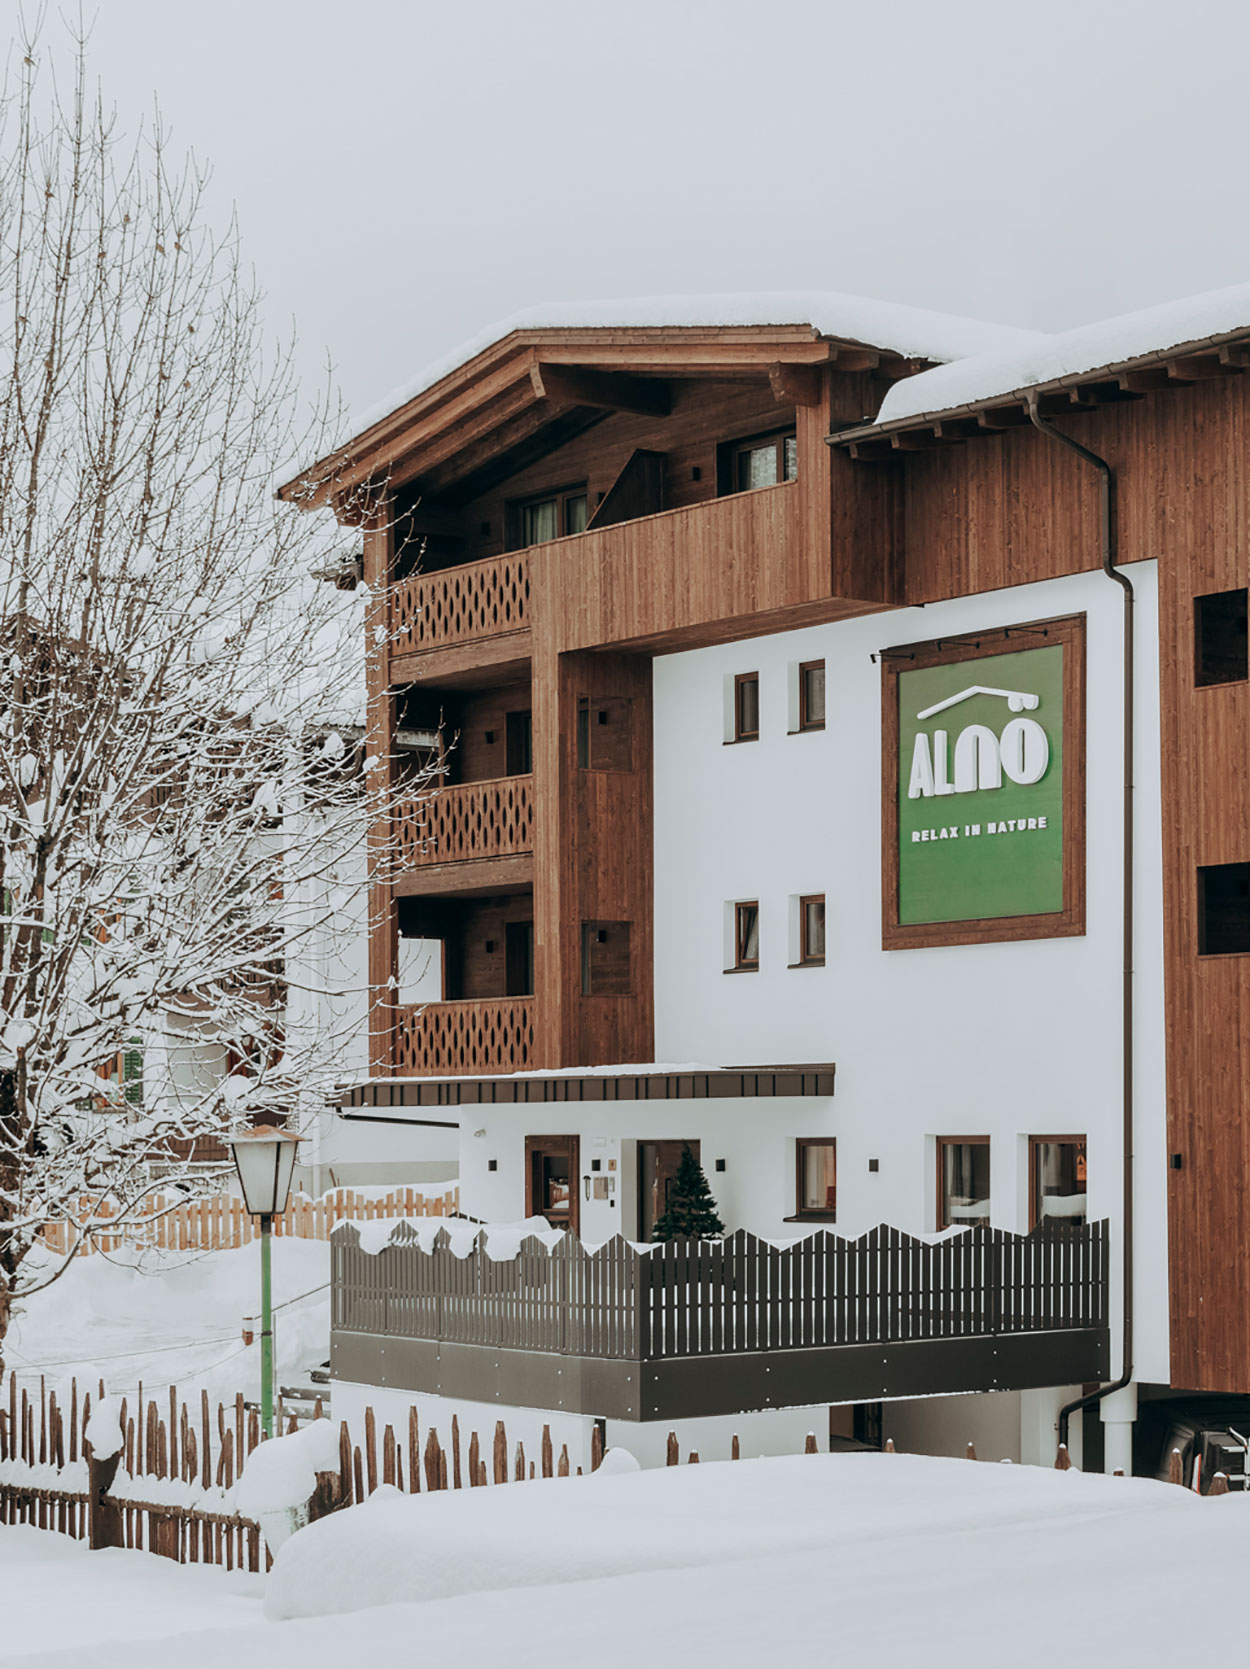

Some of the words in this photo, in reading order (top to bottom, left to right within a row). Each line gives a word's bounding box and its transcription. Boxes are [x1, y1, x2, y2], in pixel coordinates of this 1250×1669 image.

[911, 826, 959, 843] RELAX
[964, 824, 981, 837] IN
[987, 816, 1048, 834] NATURE
